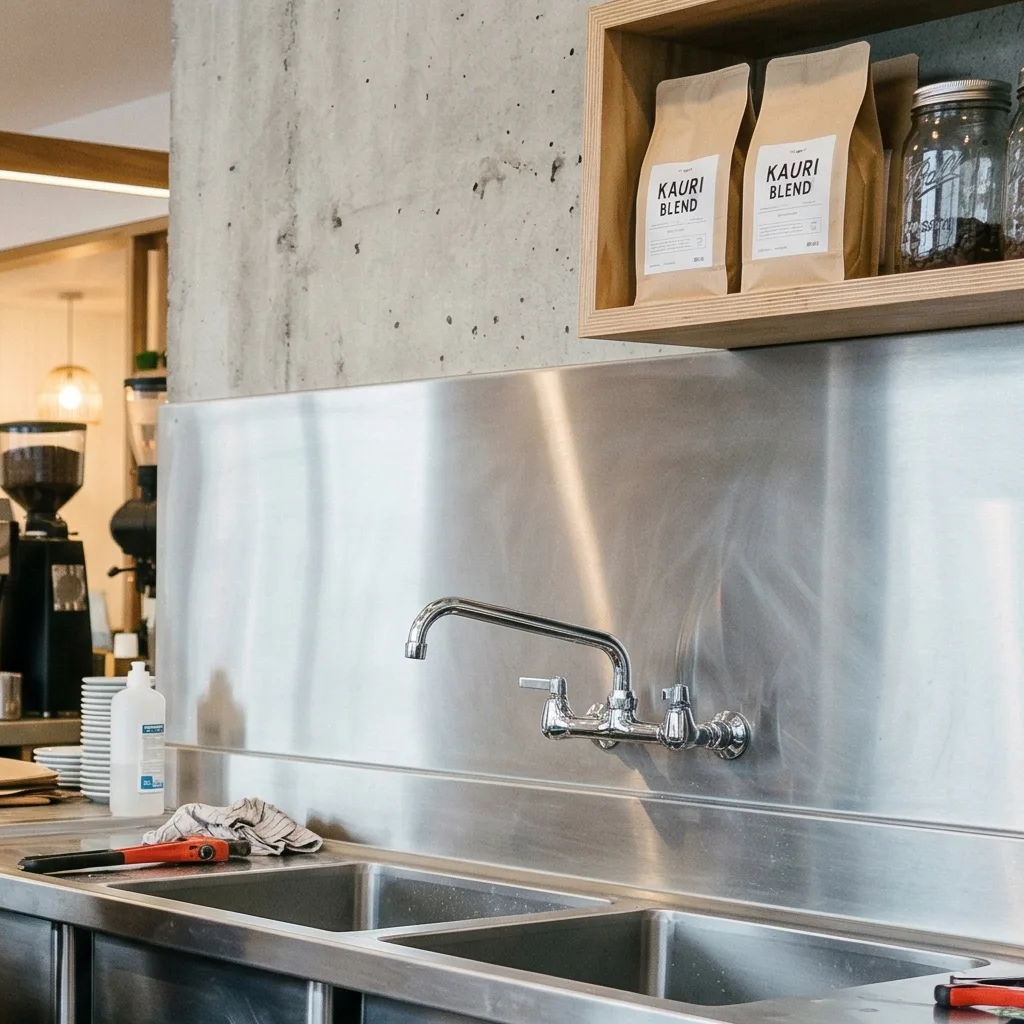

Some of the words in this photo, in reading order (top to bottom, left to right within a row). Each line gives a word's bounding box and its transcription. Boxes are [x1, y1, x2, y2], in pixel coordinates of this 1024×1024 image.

[766, 158, 819, 182] KAURI
[658, 177, 704, 199] KAURI
[769, 181, 812, 199] BLEND
[660, 199, 698, 216] BLEND
